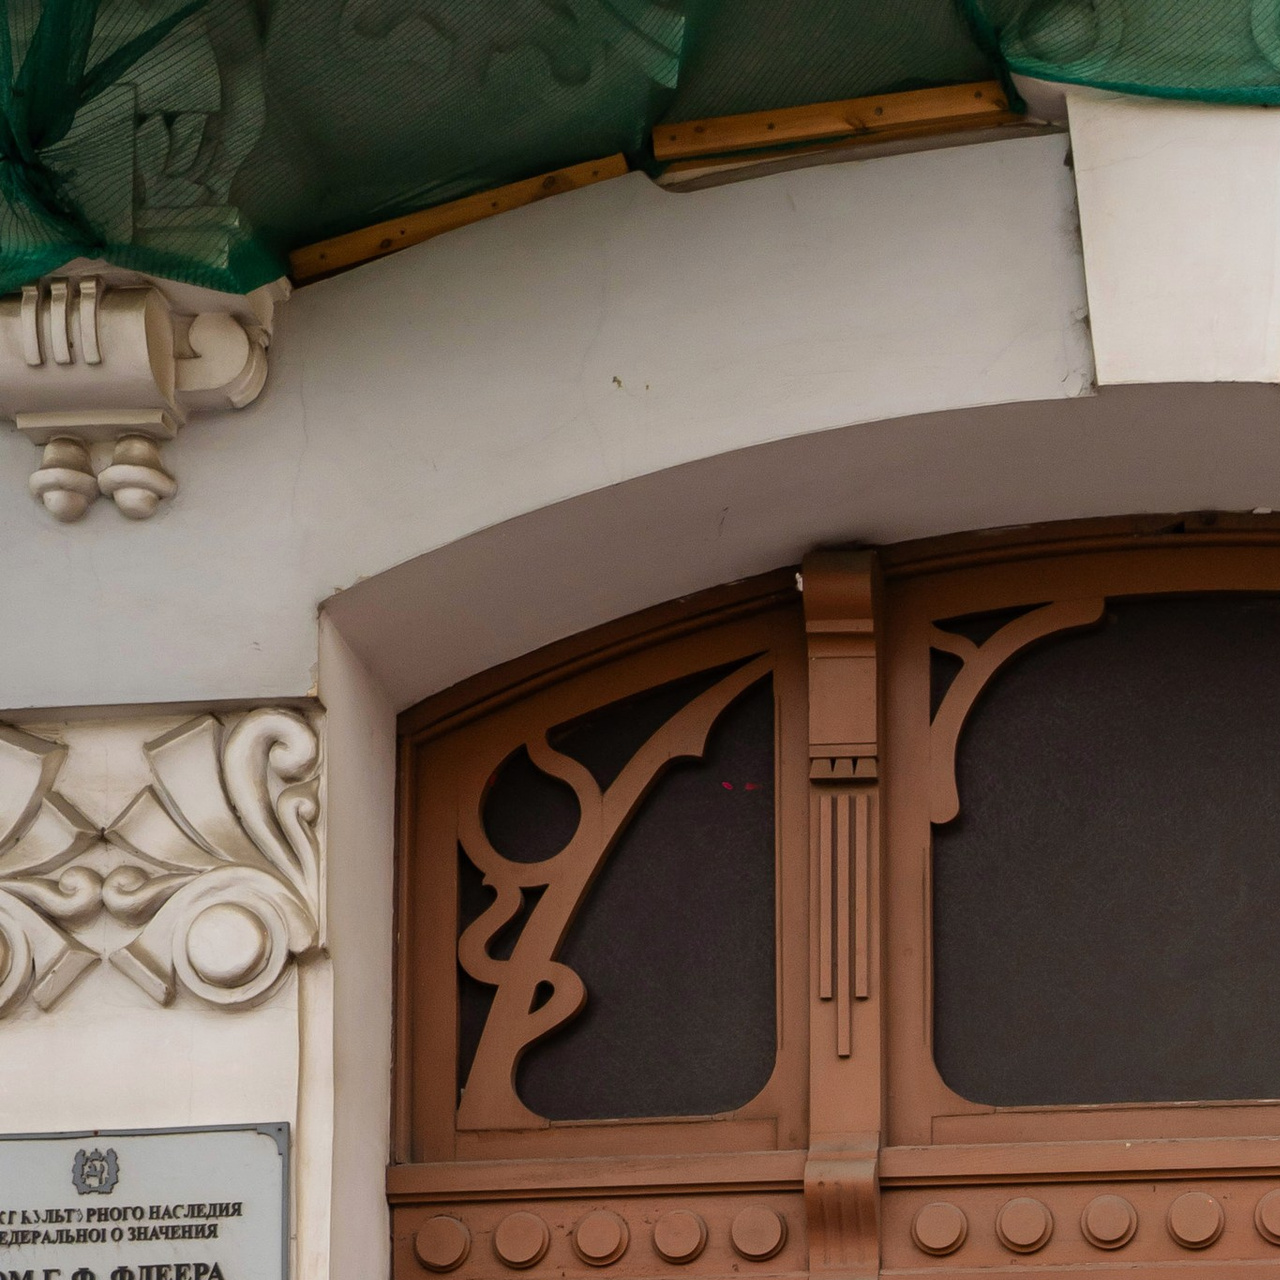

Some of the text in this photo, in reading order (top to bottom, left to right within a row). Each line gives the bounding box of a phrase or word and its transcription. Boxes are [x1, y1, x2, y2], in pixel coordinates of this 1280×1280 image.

[149, 1202, 242, 1220] НАСЛЕДИЯ
[0, 1224, 218, 1246] ЕДЕРАЛЬНОГО ЗНАЧЕНИЯ
